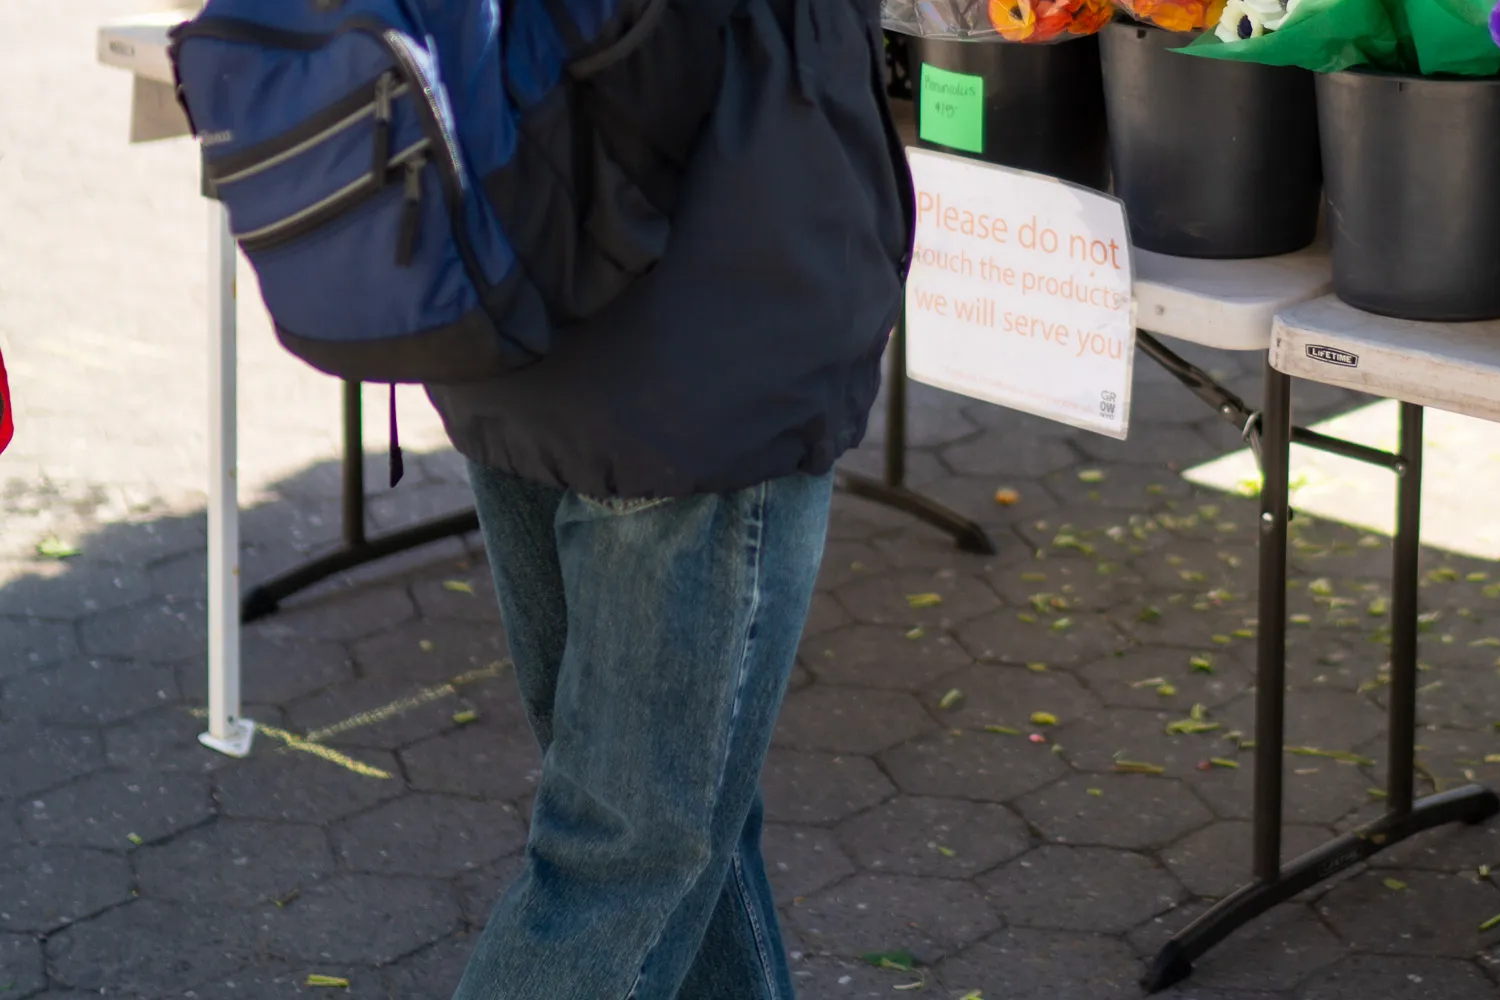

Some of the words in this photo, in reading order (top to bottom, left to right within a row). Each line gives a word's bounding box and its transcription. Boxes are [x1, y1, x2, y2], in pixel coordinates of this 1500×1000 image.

[917, 191, 1008, 243] Please
[1018, 215, 1058, 254] do
[1069, 233, 1121, 270] not
[914, 243, 973, 276] touch
[979, 257, 1015, 286] the
[1022, 271, 1123, 311] products
[914, 288, 947, 316] we
[954, 297, 995, 328] will
[1003, 311, 1069, 346] serve
[1076, 327, 1123, 360] you
[1312, 347, 1353, 364] LIFETIME
[1100, 390, 1117, 403] GR
[1100, 401, 1116, 414] OW
